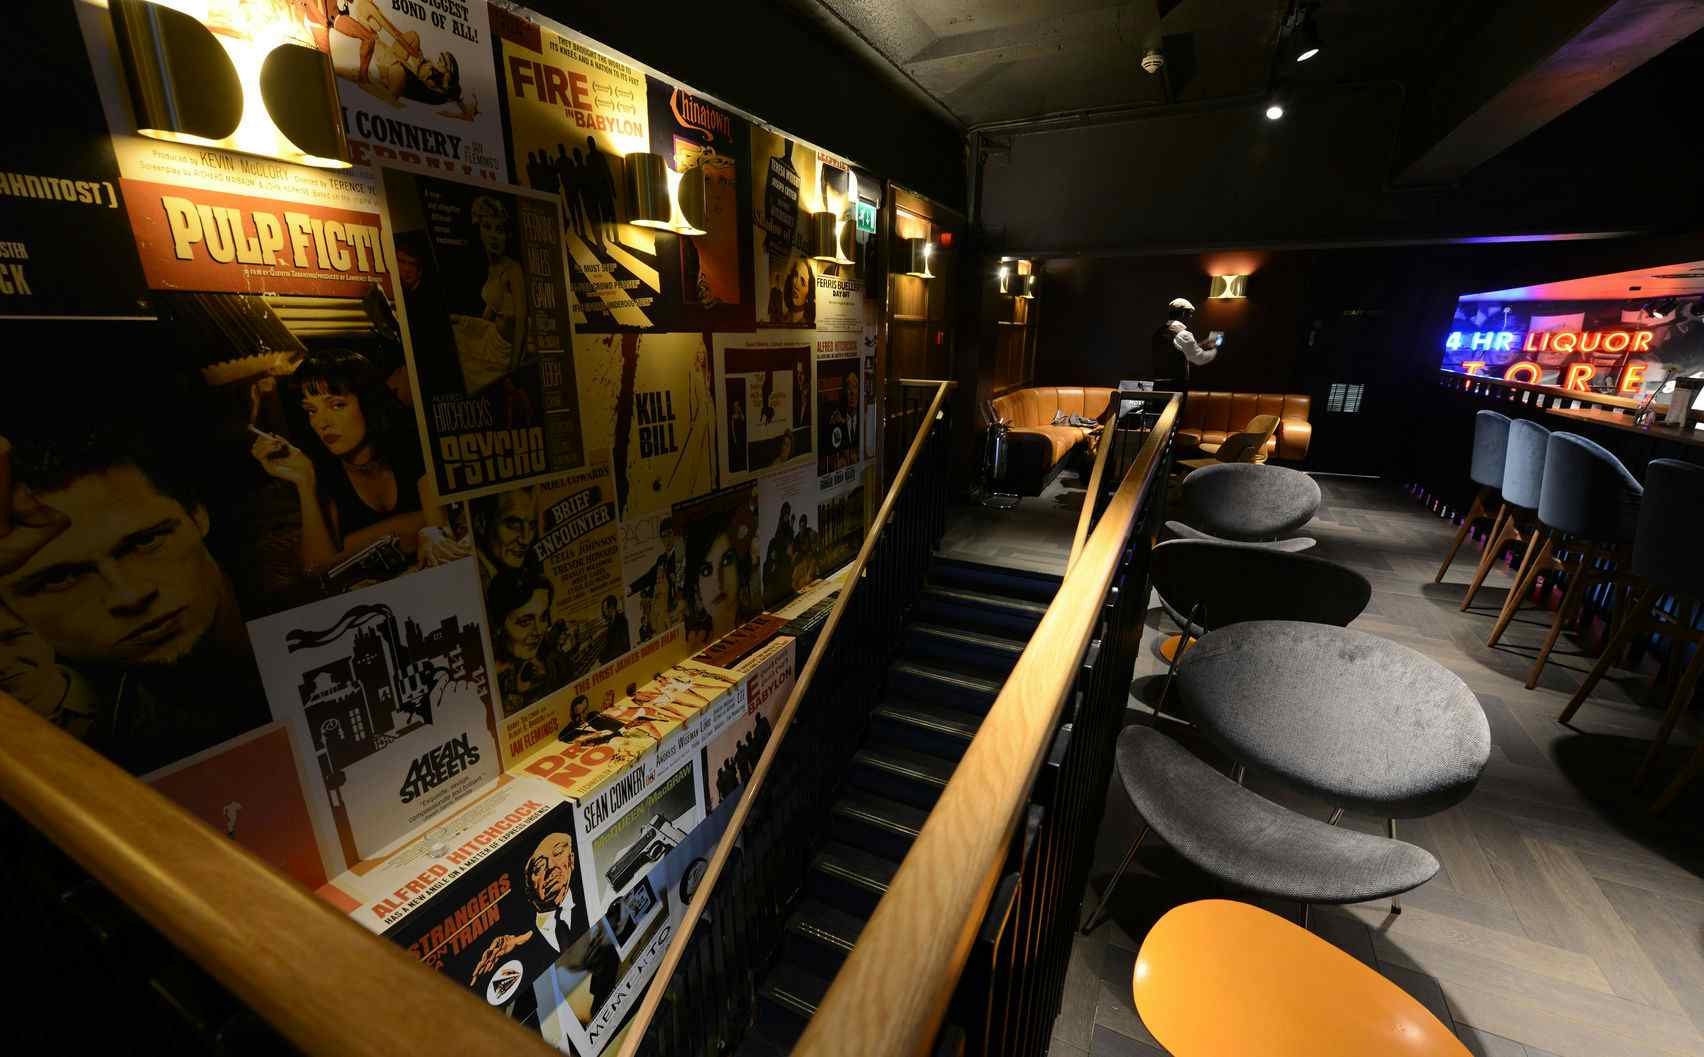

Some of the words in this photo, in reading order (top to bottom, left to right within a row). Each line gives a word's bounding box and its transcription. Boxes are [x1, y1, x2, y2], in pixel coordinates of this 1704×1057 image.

[392, 0, 419, 21] BOND
[432, 11, 446, 30] OF
[453, 19, 479, 44] ALL!
[549, 41, 559, 52] ITS
[560, 44, 578, 60] KNEES
[578, 54, 589, 65] AND
[590, 59, 595, 67] A
[594, 61, 613, 77] NATION
[613, 69, 620, 78] TO
[558, 36, 572, 48] THEY
[573, 41, 597, 59] BROUGHT
[598, 53, 607, 64] THE
[508, 56, 593, 112] FIRE
[355, 110, 462, 161] CONNERY
[565, 108, 575, 120] IN
[575, 111, 643, 138] BABYLON
[669, 86, 733, 142] Chinatown
[200, 151, 234, 171] KEVIN
[328, 176, 365, 194] TERENCE
[161, 196, 284, 266] PULP
[817, 277, 837, 289] FERRIS
[1471, 331, 1513, 351] HR
[1523, 331, 1654, 352] LIQUOR
[636, 390, 676, 427] KILL
[440, 427, 546, 490] PSYCHO
[639, 423, 678, 459] BILL
[551, 490, 593, 525] BRIEF
[534, 505, 611, 562] ENCOUNTER
[748, 666, 791, 714] BABYLON
[403, 732, 471, 784] MEAN
[511, 736, 524, 758] IAN
[547, 745, 615, 789] NO
[399, 746, 480, 804] STREETS
[584, 792, 609, 835] SEAN
[609, 763, 646, 814] CONNERY
[371, 863, 449, 919] ALFRED
[446, 800, 543, 865] HITCHCOCK
[384, 908, 402, 925] HAS
[402, 905, 410, 913] A
[409, 893, 426, 908] NEW
[425, 877, 450, 897] ANGLE
[450, 869, 460, 881] ON
[459, 864, 465, 873] A
[464, 849, 490, 868] MATTER
[489, 840, 500, 850] OF
[499, 824, 526, 844] EXPRESS
[410, 873, 512, 961] STRANGERS
[448, 905, 501, 956] TRAIN
